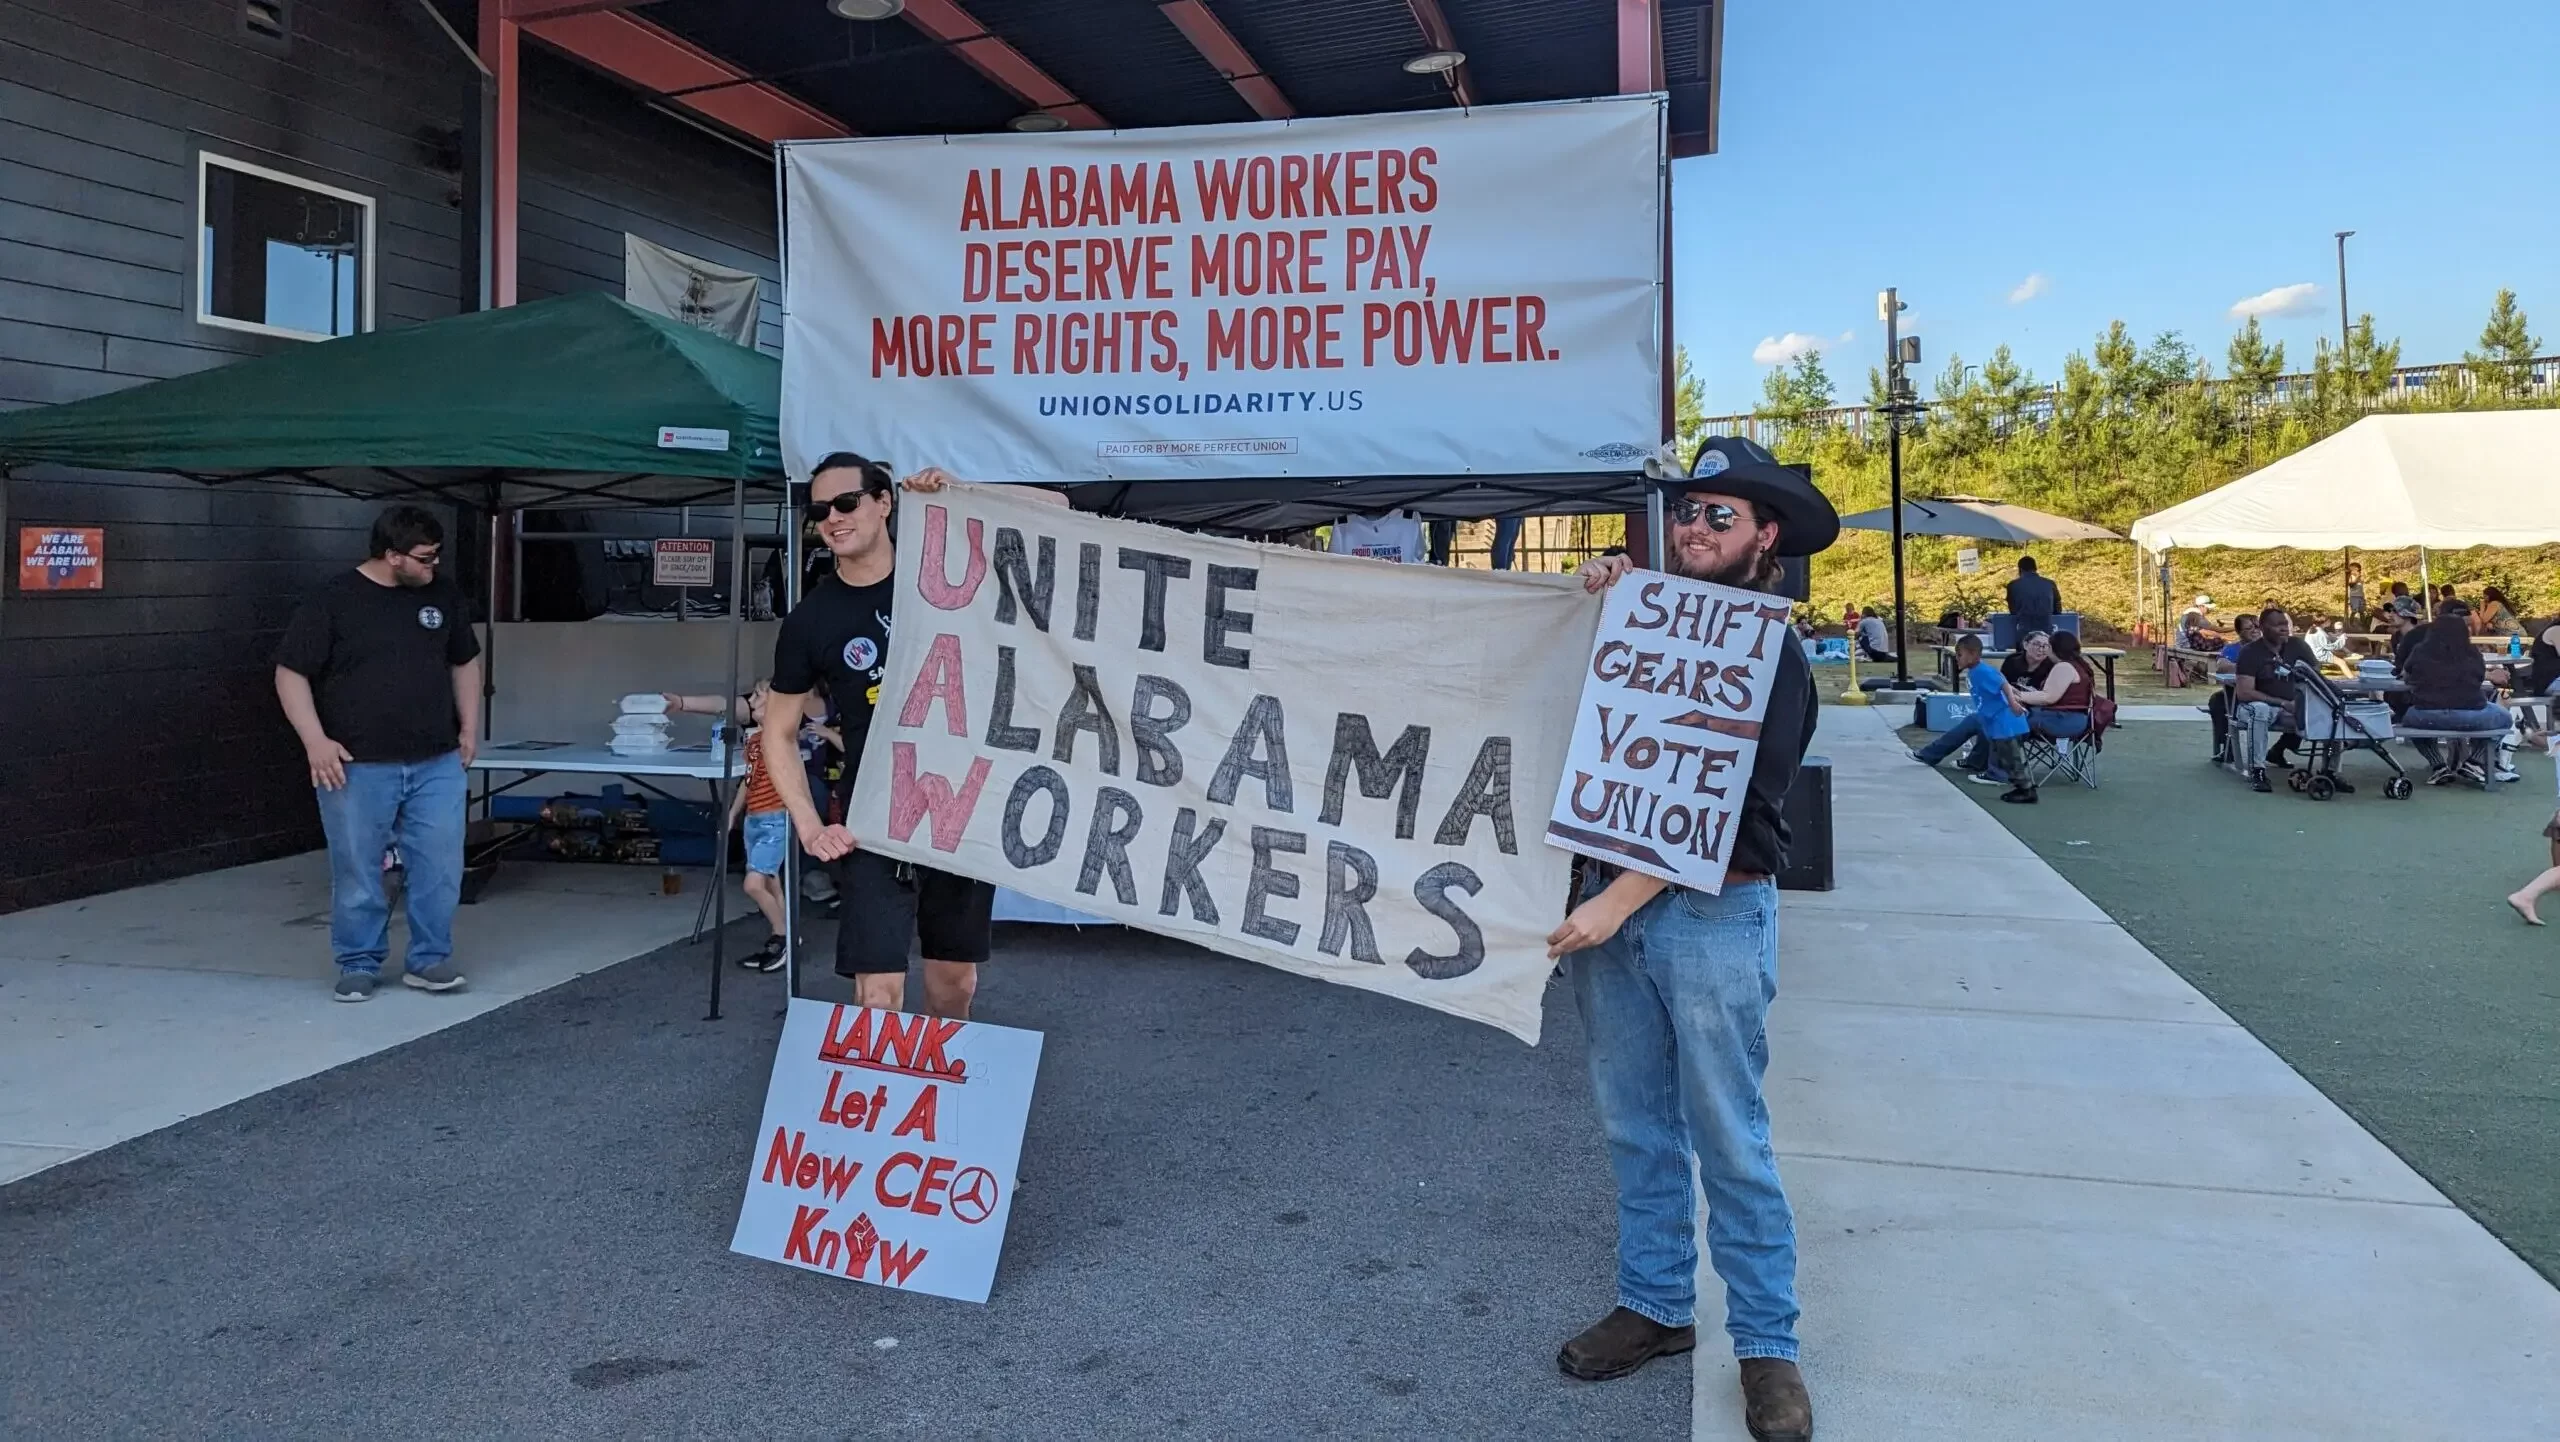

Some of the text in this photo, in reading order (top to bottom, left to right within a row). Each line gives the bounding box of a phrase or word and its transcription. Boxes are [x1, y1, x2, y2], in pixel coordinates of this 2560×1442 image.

[960, 146, 1439, 232] ALABAMA WORKERS
[962, 224, 1437, 304] DESERVE MORE PAY,
[871, 295, 1560, 381] MORE RIGHTS, MORE POWER.
[1037, 389, 1365, 418] UNIONSOLIDARITY.US
[1105, 440, 1288, 455] PAID FOR BY MORE PERFECT UNION
[26, 556, 98, 566] WE ARE UAW
[34, 545, 89, 555] ALABAMA
[41, 534, 85, 544] WE ARE
[660, 542, 709, 551] ATTENTION
[916, 503, 1259, 670] UNITE
[1625, 582, 1791, 661] SHIFT
[1593, 640, 1755, 712] GEARS
[898, 633, 1517, 855] ALABAMA
[1596, 703, 1740, 800] VOTE
[1571, 770, 1732, 863] UNION
[887, 742, 1486, 980] WORKERS
[819, 1070, 938, 1142] Let A
[762, 1126, 863, 1203] New
